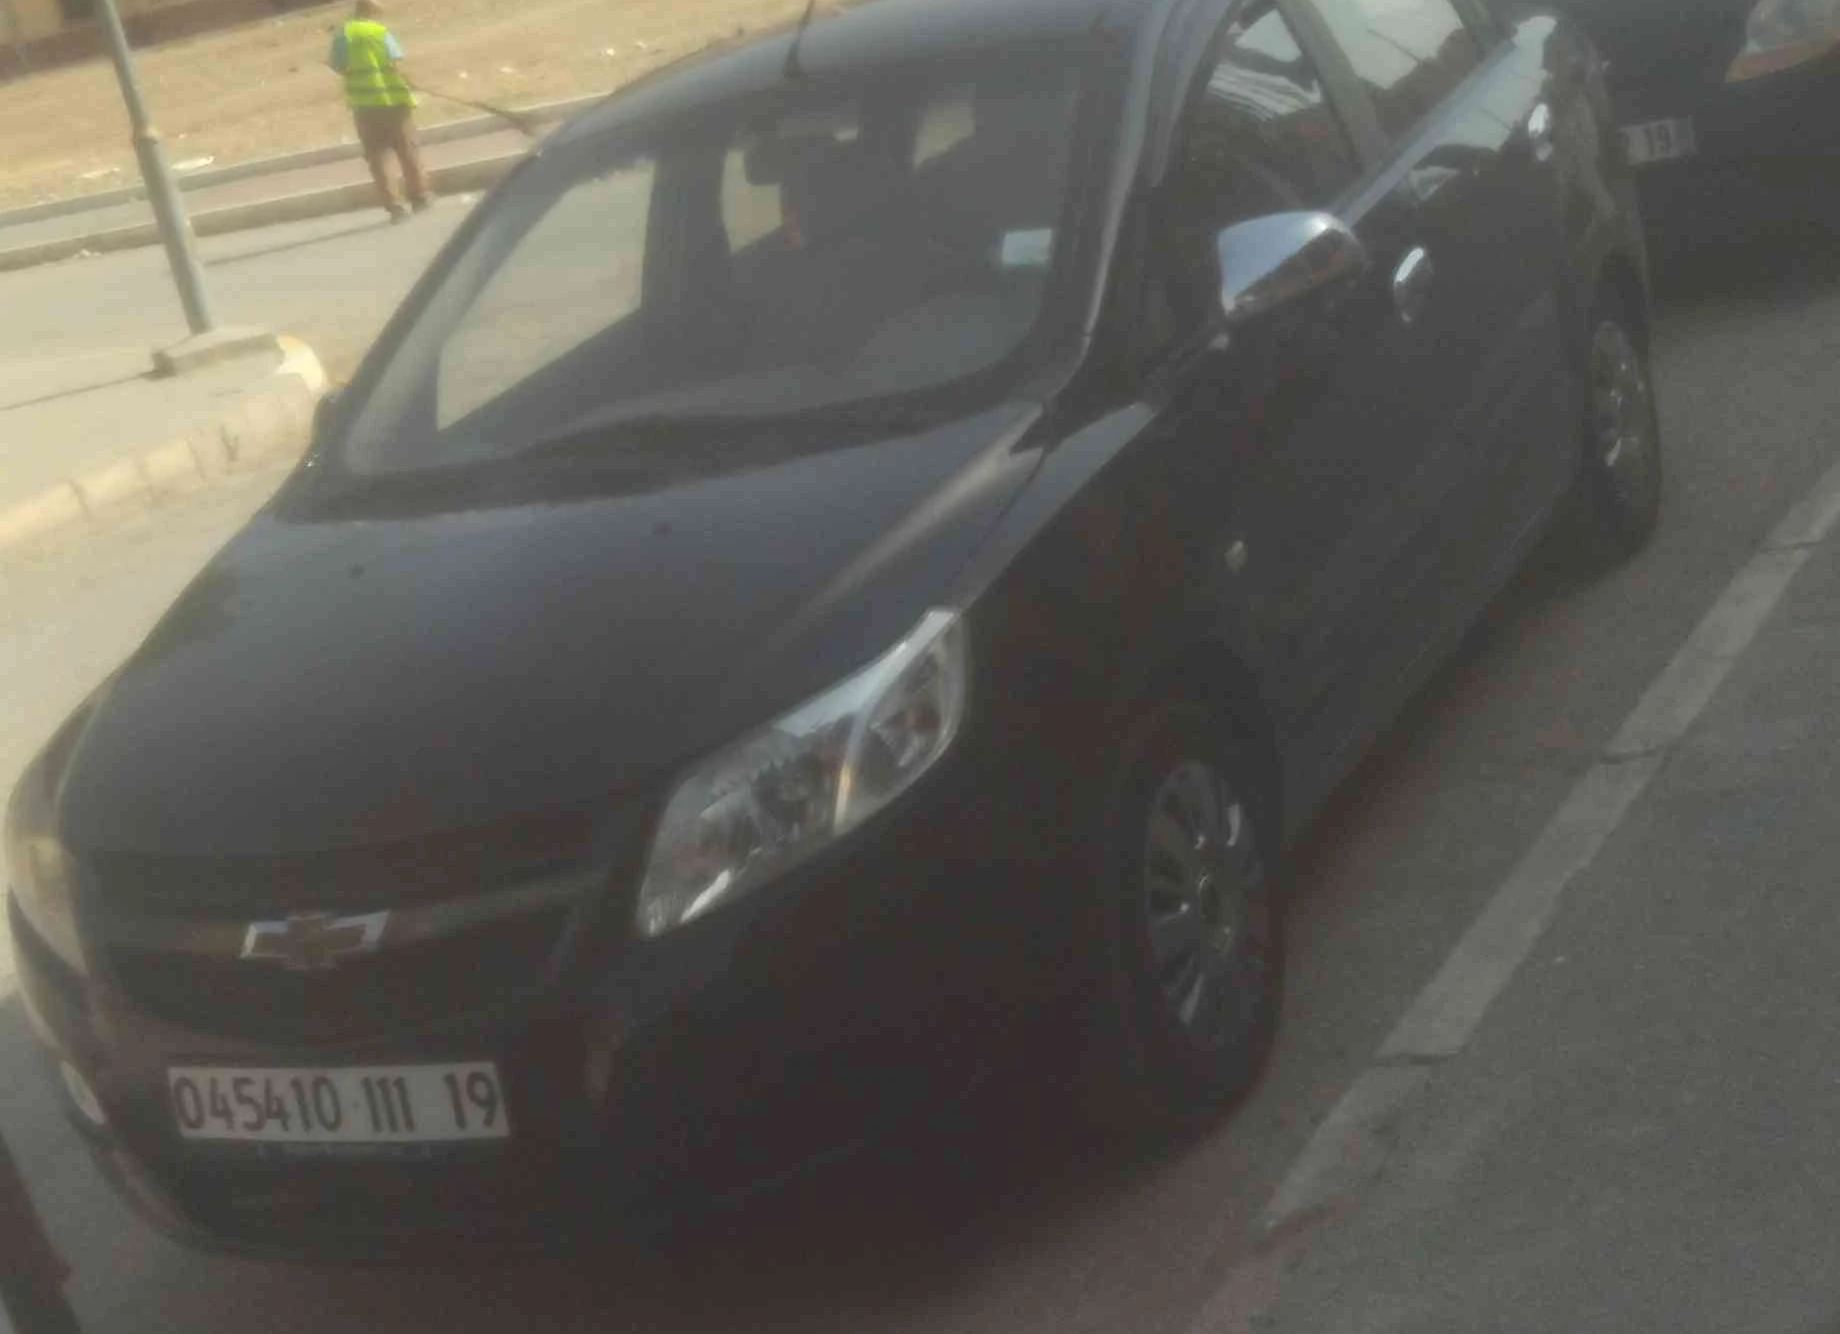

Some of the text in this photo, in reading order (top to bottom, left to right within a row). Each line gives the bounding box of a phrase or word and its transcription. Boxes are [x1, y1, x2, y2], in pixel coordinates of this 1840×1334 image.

[173, 1072, 498, 1133] 045410 111 19
